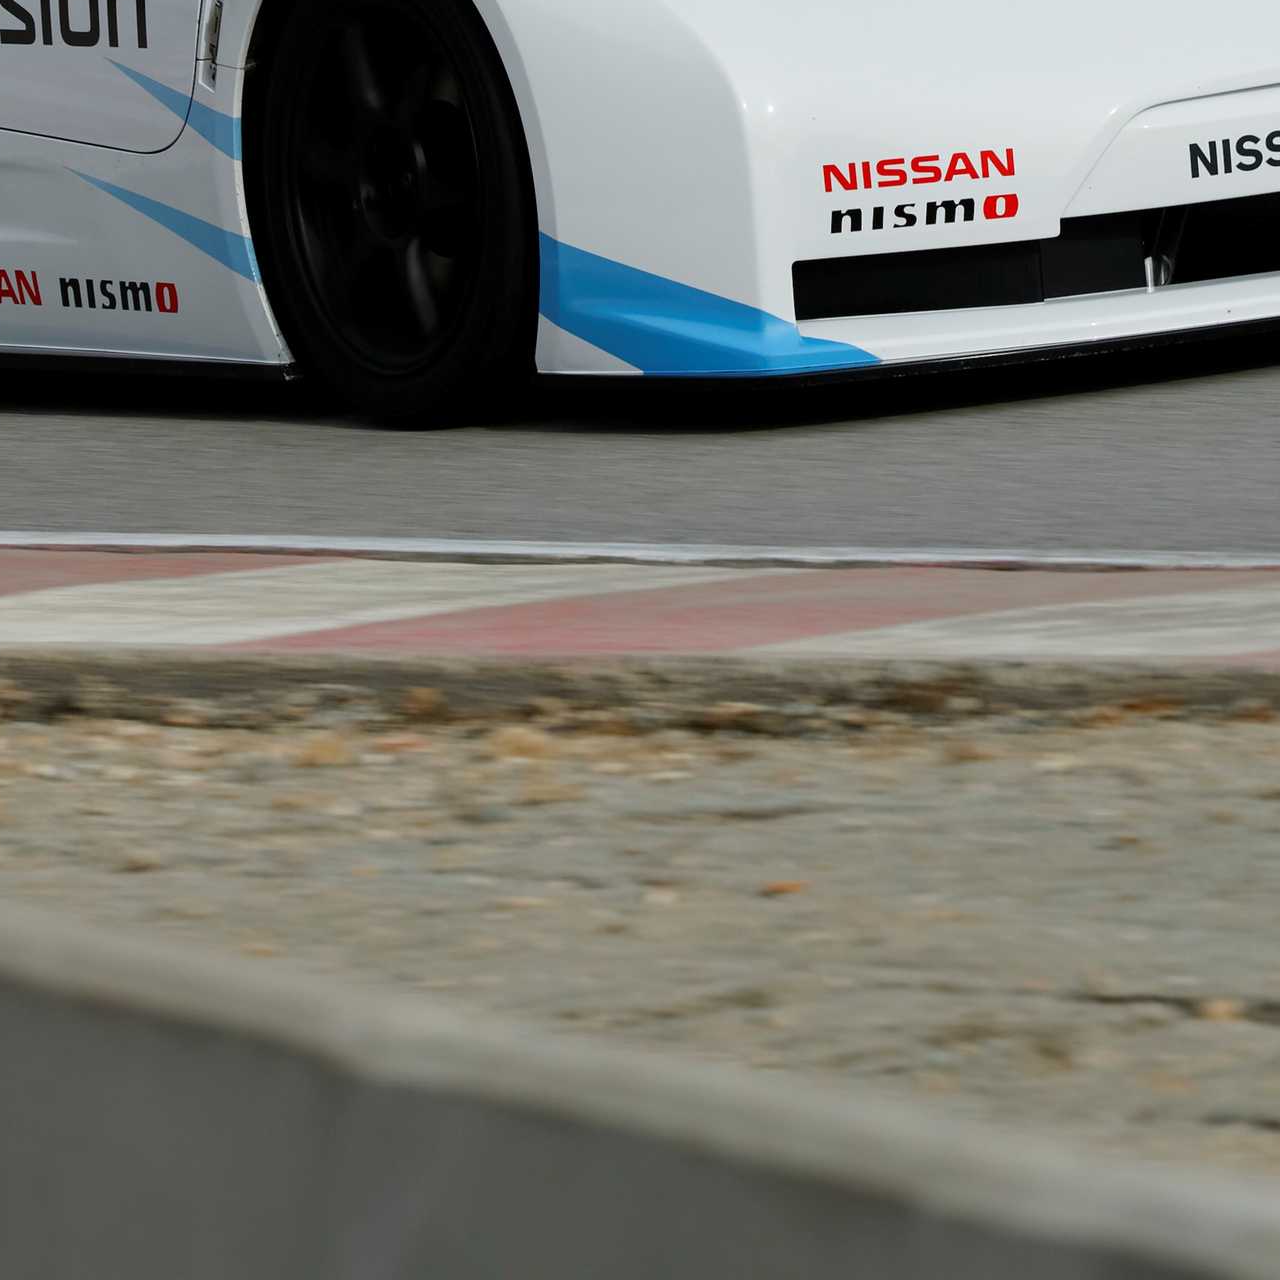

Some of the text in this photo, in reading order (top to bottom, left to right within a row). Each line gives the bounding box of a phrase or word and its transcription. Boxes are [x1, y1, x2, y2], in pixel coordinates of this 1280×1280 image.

[822, 147, 1016, 193] NISSAN
[829, 193, 1020, 234] nismo
[59, 276, 179, 314] nismo
